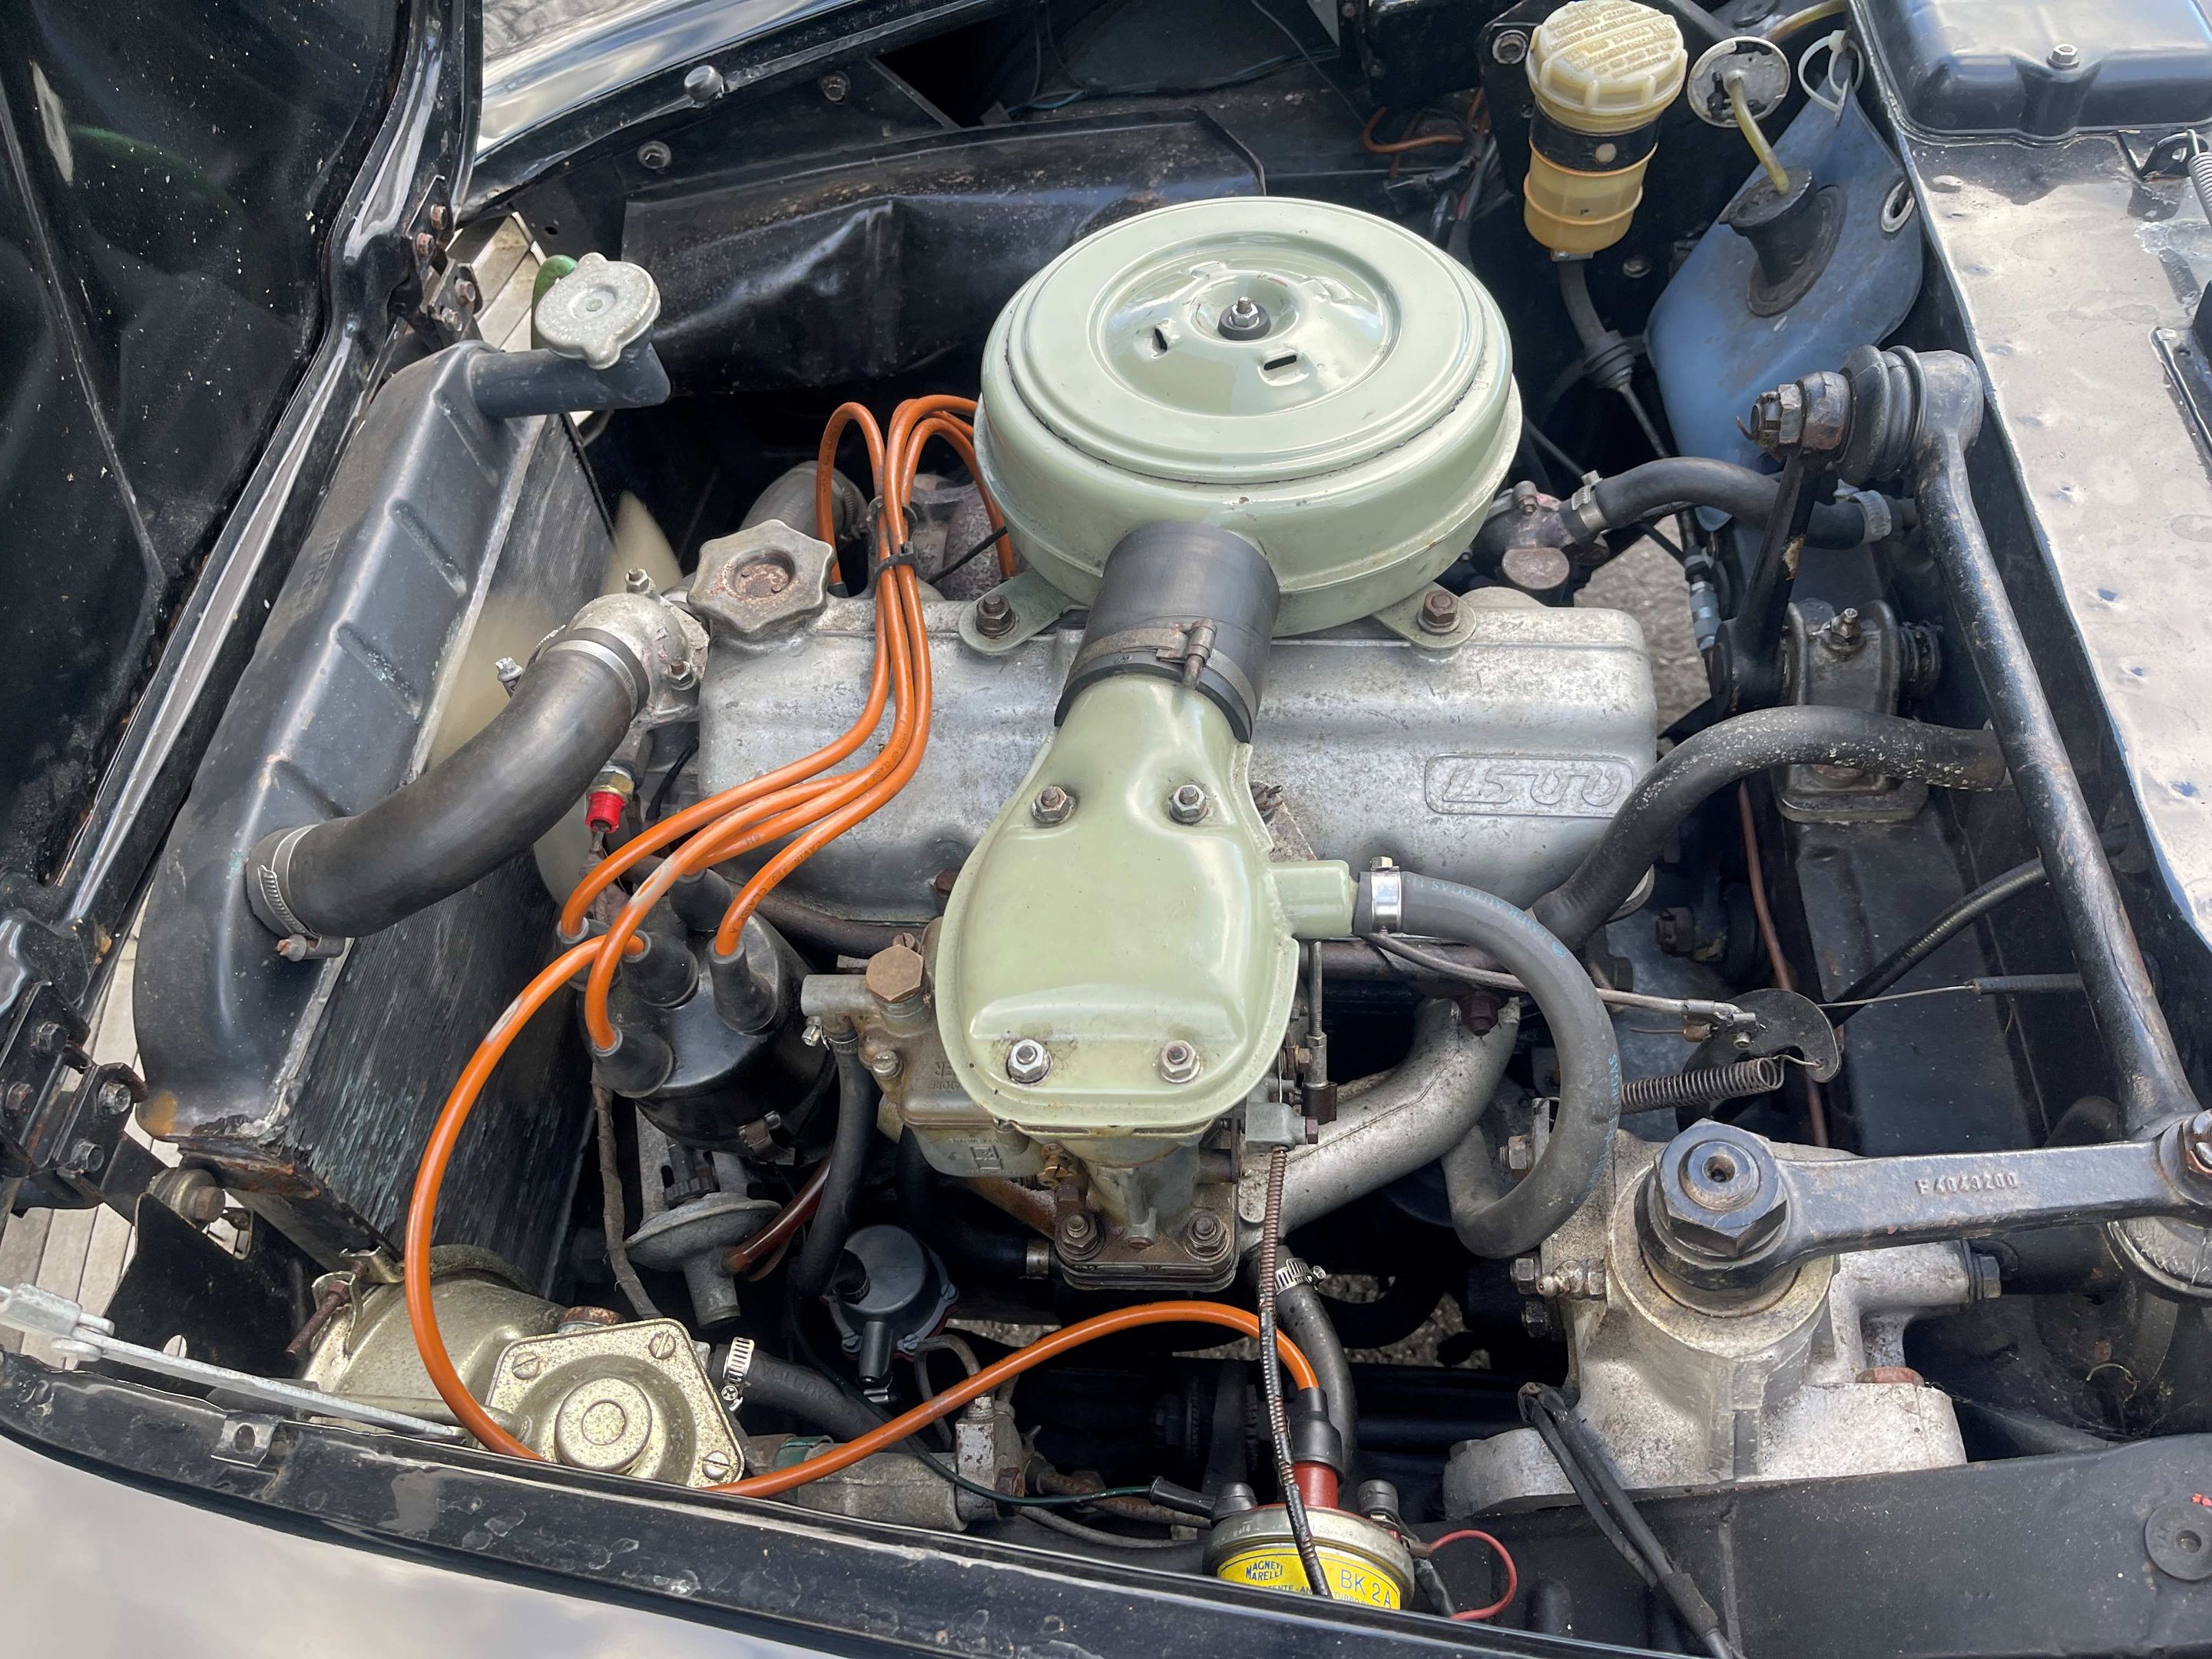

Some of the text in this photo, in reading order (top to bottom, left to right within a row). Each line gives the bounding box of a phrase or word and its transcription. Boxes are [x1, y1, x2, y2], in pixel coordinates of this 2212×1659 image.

[1246, 1560, 1283, 1575] MAGNETI
[1246, 1568, 1283, 1581] MARELLI
[1340, 1568, 1366, 1595] BK
